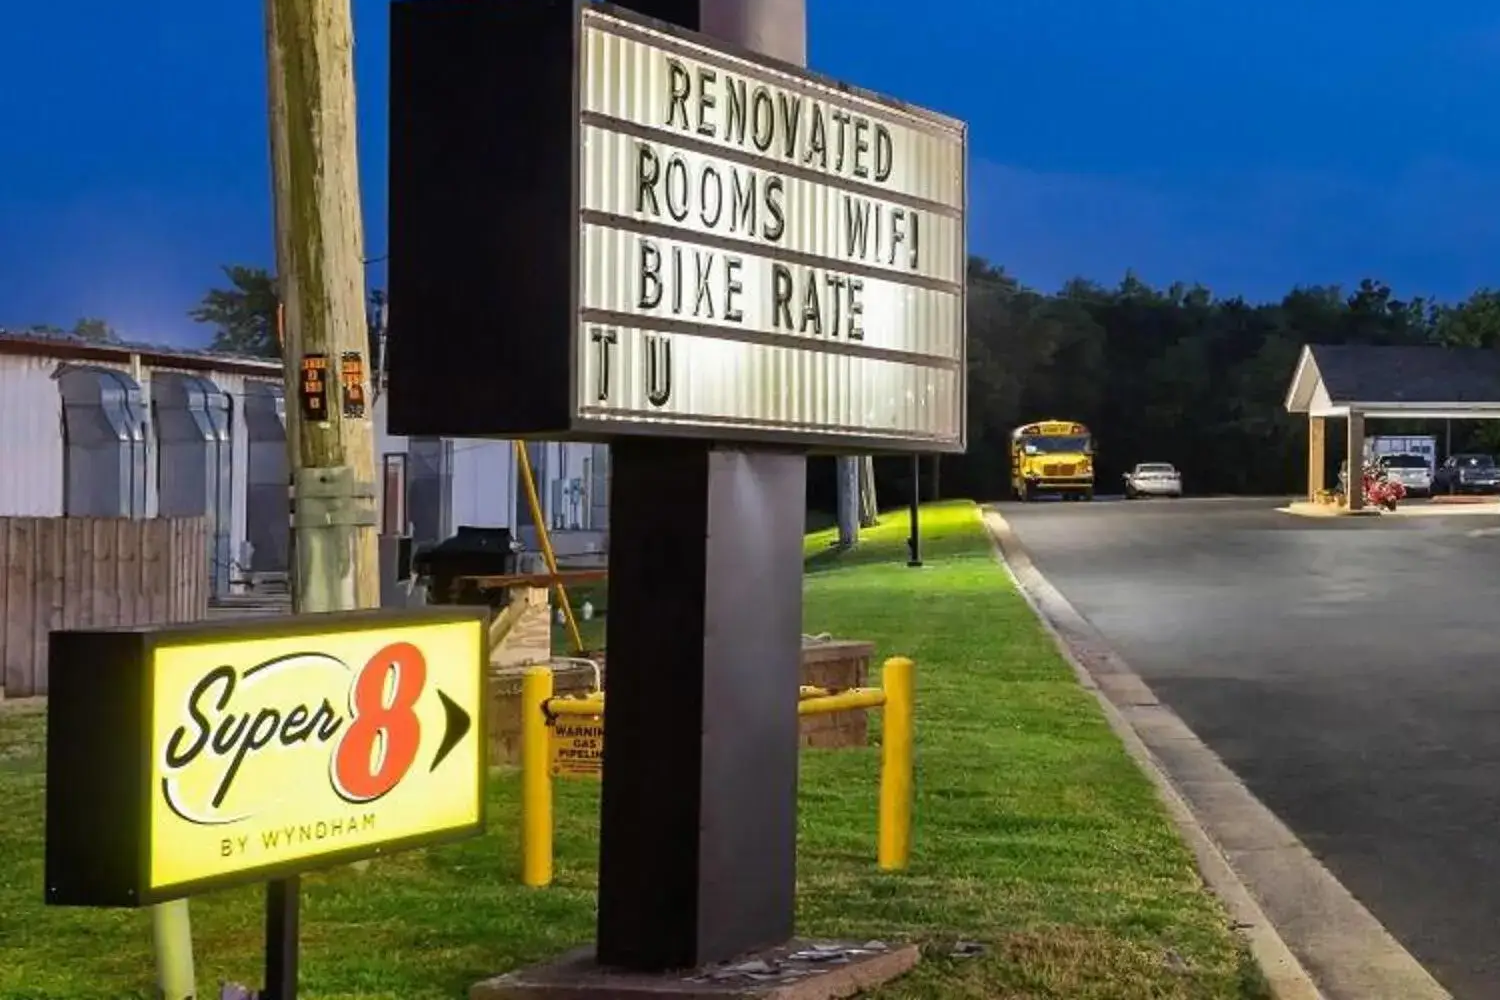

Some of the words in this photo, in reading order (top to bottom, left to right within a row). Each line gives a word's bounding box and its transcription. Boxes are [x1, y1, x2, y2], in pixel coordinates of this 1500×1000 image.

[665, 57, 893, 183] RENOVATED
[635, 142, 785, 241] ROOMS
[843, 195, 919, 270] WIFI
[637, 239, 743, 323] BIKE
[772, 262, 865, 341] RATE
[166, 665, 343, 808] Super
[328, 641, 427, 804] 8
[573, 739, 597, 749] GAS
[220, 835, 249, 857] BY
[262, 813, 376, 849] WYNDHAM
